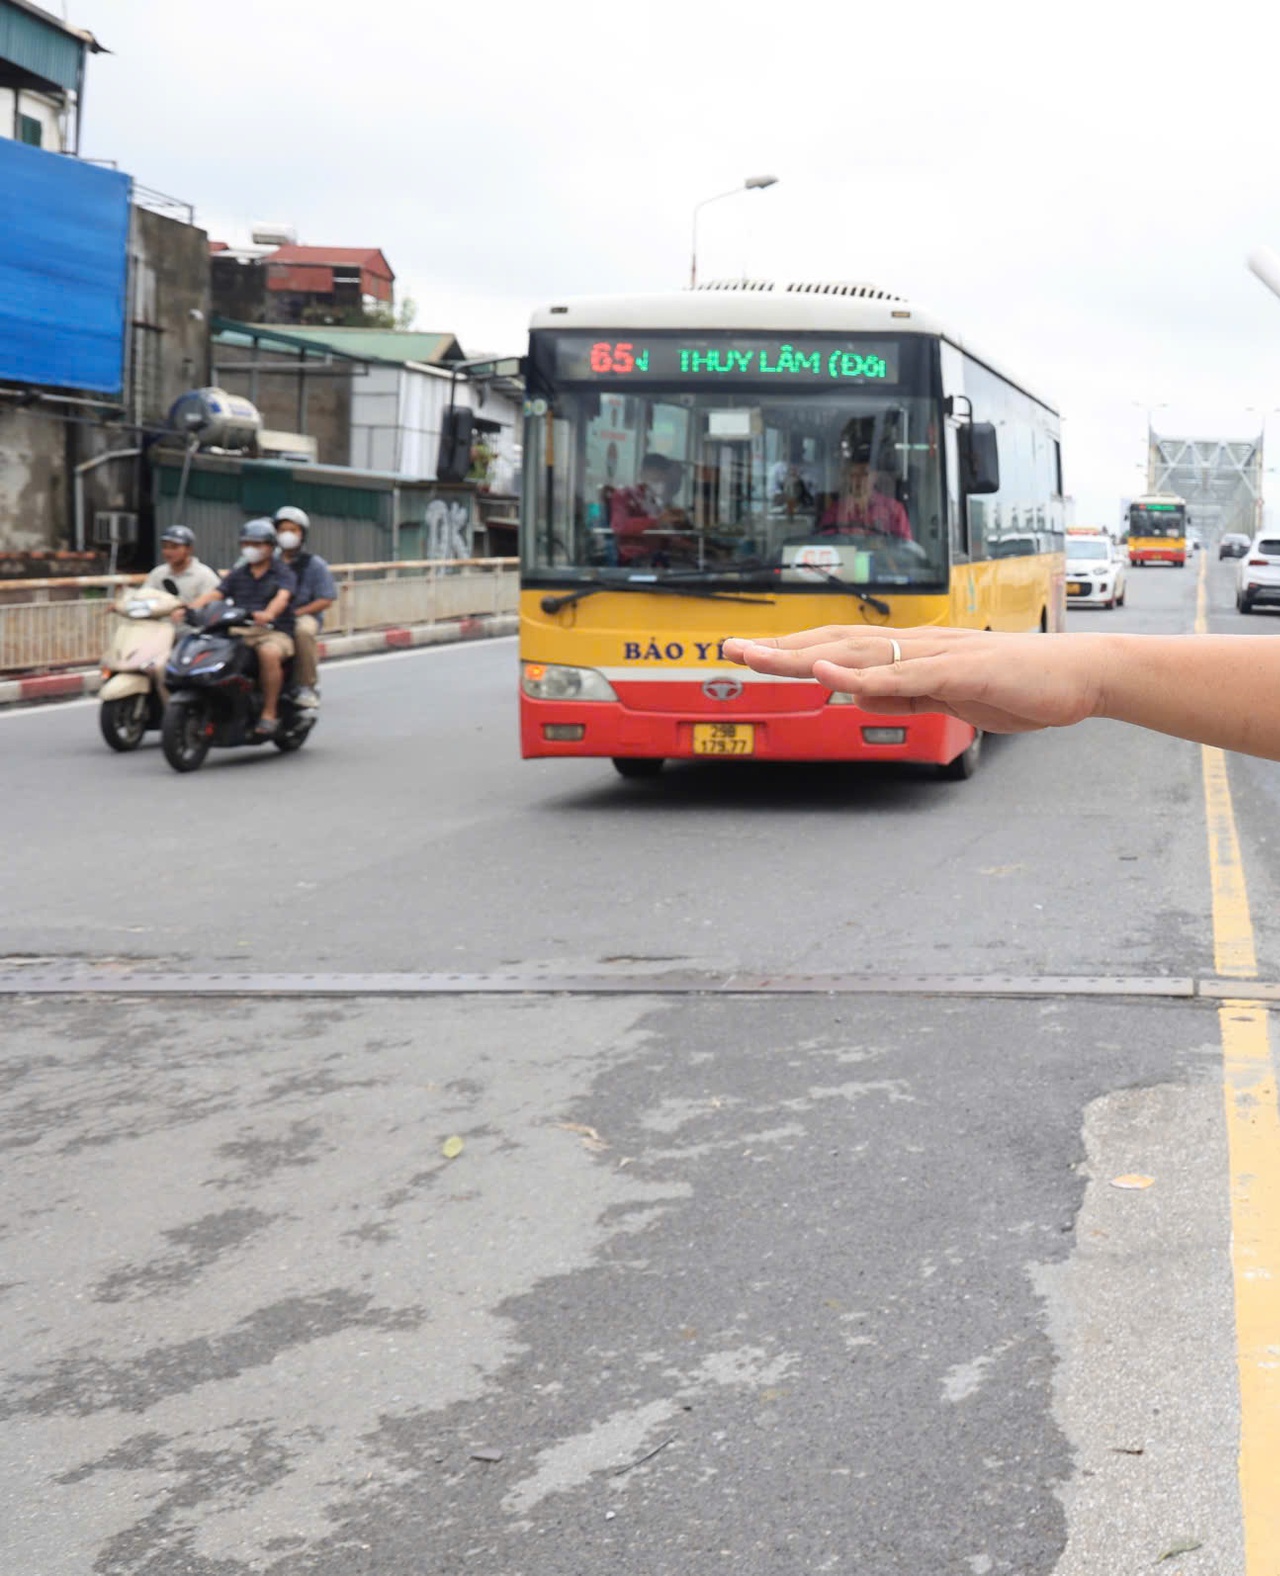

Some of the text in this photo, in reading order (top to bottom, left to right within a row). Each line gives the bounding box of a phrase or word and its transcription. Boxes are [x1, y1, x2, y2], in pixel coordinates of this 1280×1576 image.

[590, 342, 634, 373] 65
[760, 344, 821, 374] LÂM
[624, 636, 684, 660] BẢO
